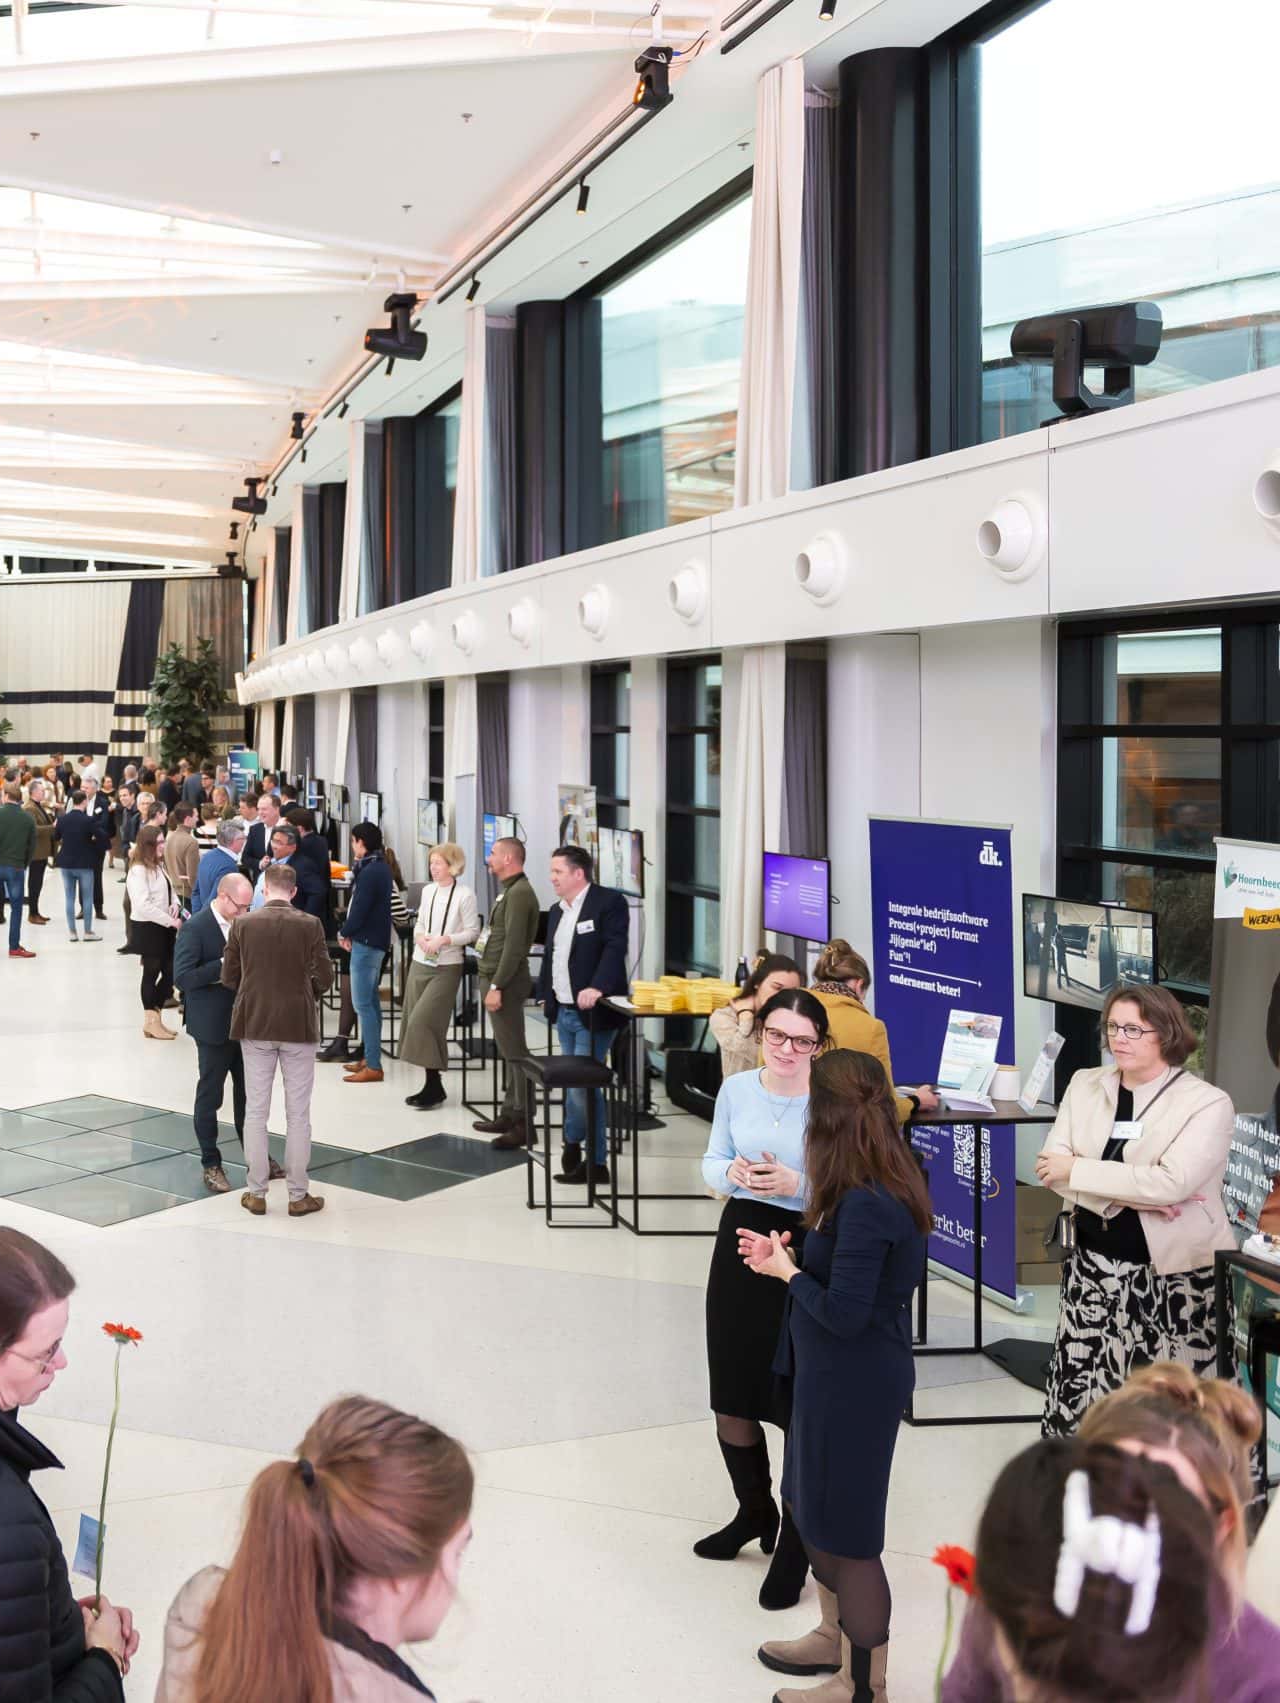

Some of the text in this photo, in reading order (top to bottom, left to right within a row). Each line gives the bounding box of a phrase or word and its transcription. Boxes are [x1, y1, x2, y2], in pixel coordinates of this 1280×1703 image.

[888, 901, 989, 928] Integrale bedrijfssoftware
[951, 928, 979, 944] format
[889, 972, 961, 998] onderneemt beter!
[1254, 1174, 1274, 1193] echt
[956, 1220, 987, 1249] betr
